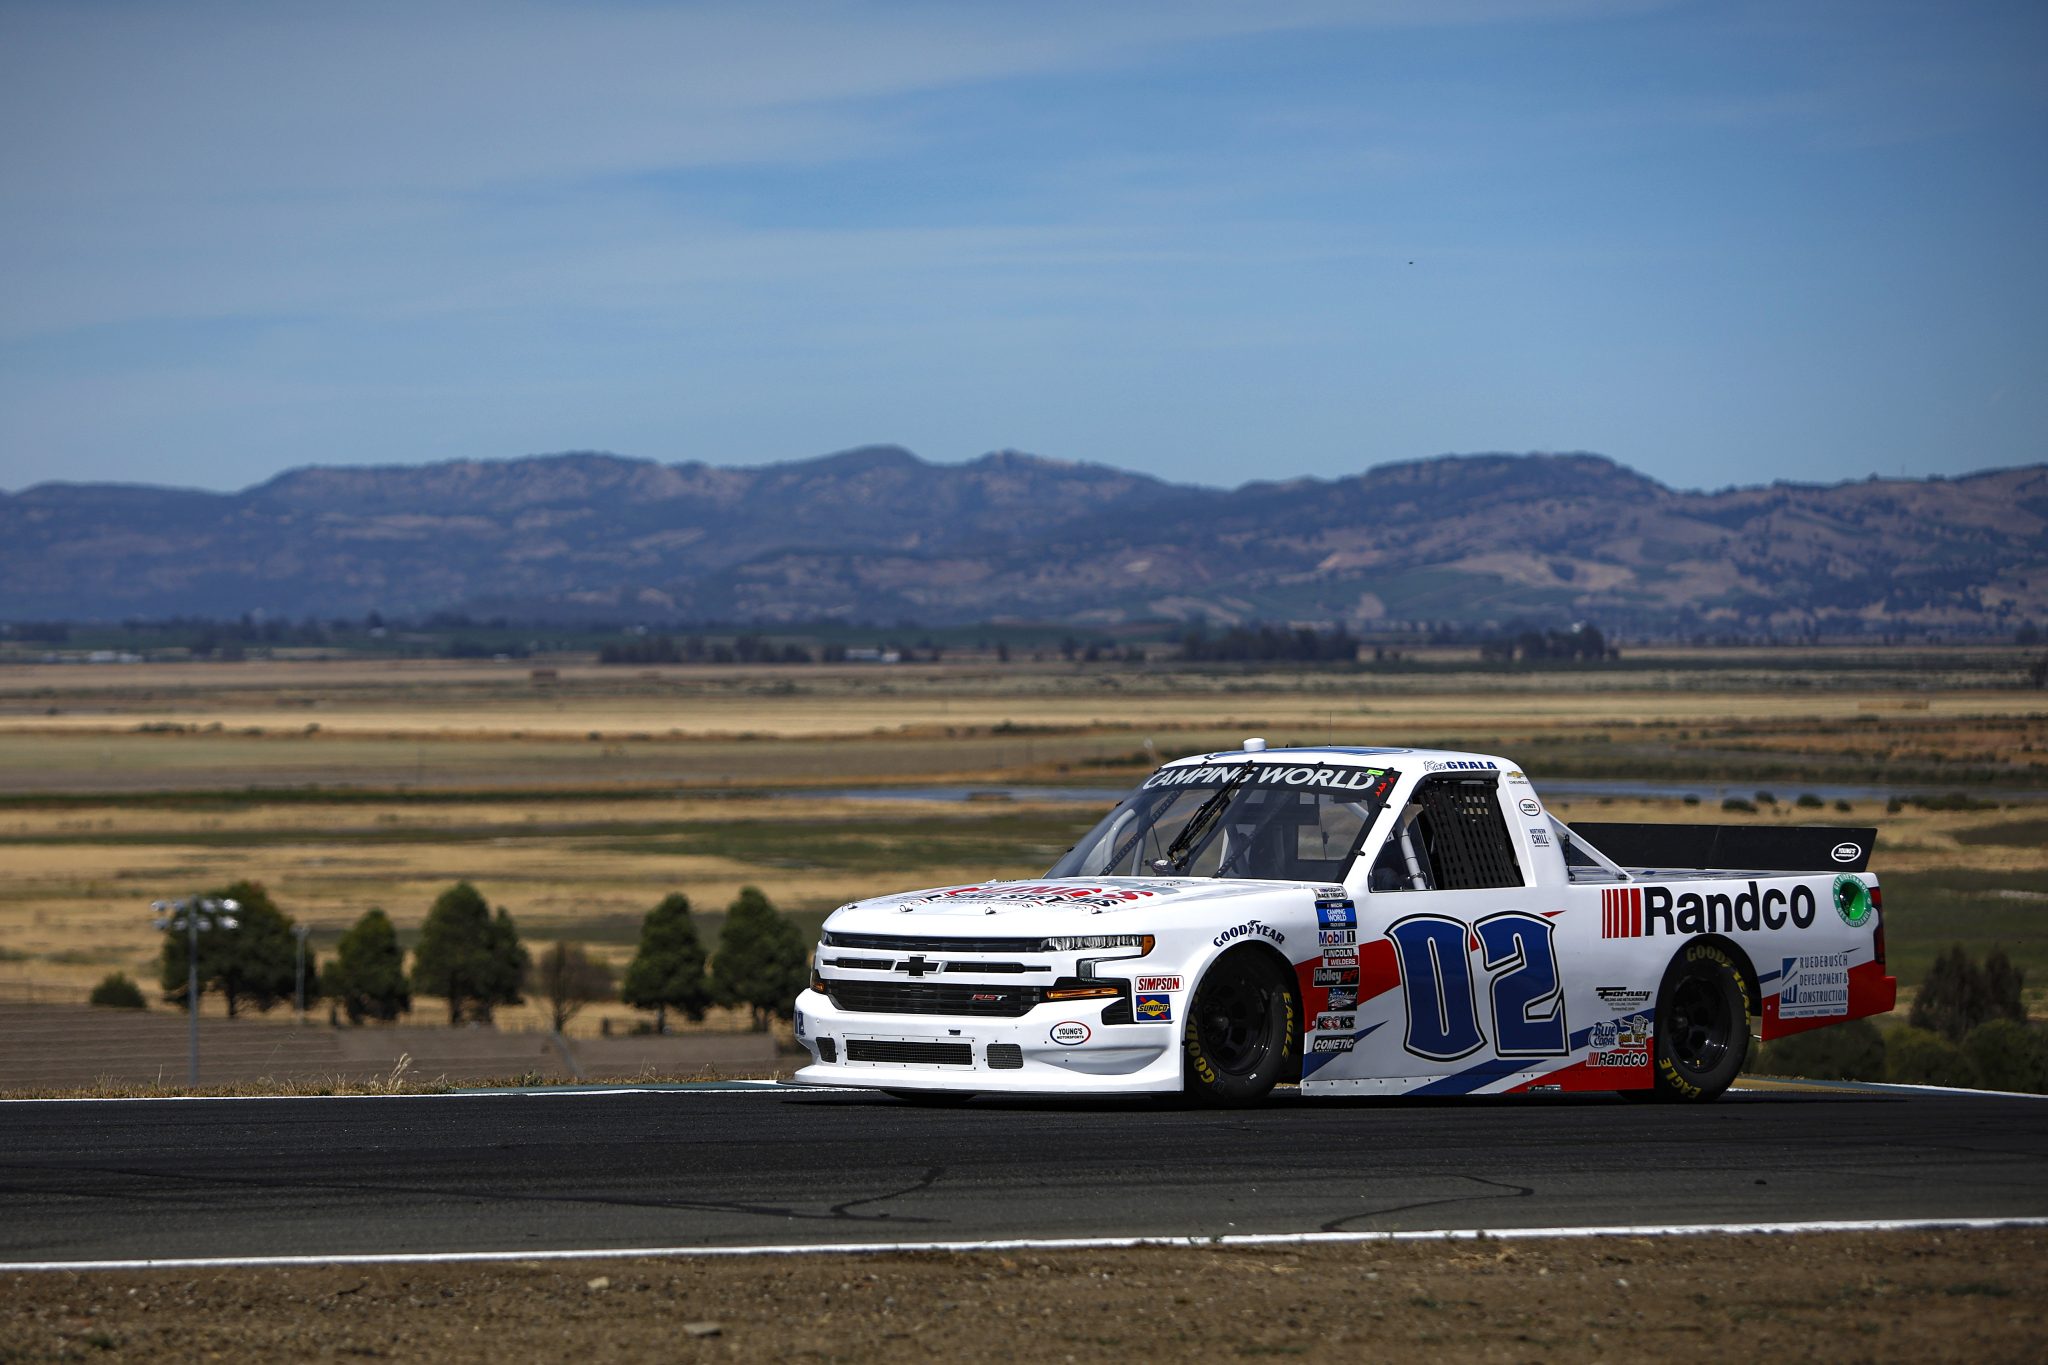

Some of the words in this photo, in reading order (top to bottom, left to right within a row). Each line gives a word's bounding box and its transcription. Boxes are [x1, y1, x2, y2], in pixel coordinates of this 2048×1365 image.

[1446, 761, 1497, 770] GRALA
[1257, 766, 1375, 790] WORLD
[1645, 881, 1816, 936] Randco
[1319, 931, 1345, 943] Mobil
[1325, 949, 1353, 958] LINCOLN
[1799, 954, 1848, 968] RUEDEBUSCH
[1315, 969, 1341, 984] Holley
[1799, 973, 1842, 986] DEVELOPMENT
[1138, 978, 1180, 991] SIMPSON
[1384, 910, 1570, 1062] 02
[1799, 990, 1847, 1003] CONSTRUCTION
[1138, 1004, 1169, 1012] SUNOCO
[1058, 1027, 1083, 1035] YOUNG'S
[1281, 991, 1295, 1060] EAGLE
[1593, 1022, 1616, 1037] BLUE
[1314, 1038, 1354, 1050] COMETIC
[1599, 1051, 1648, 1066] Randco
[1658, 1057, 1702, 1099] EAGLE
